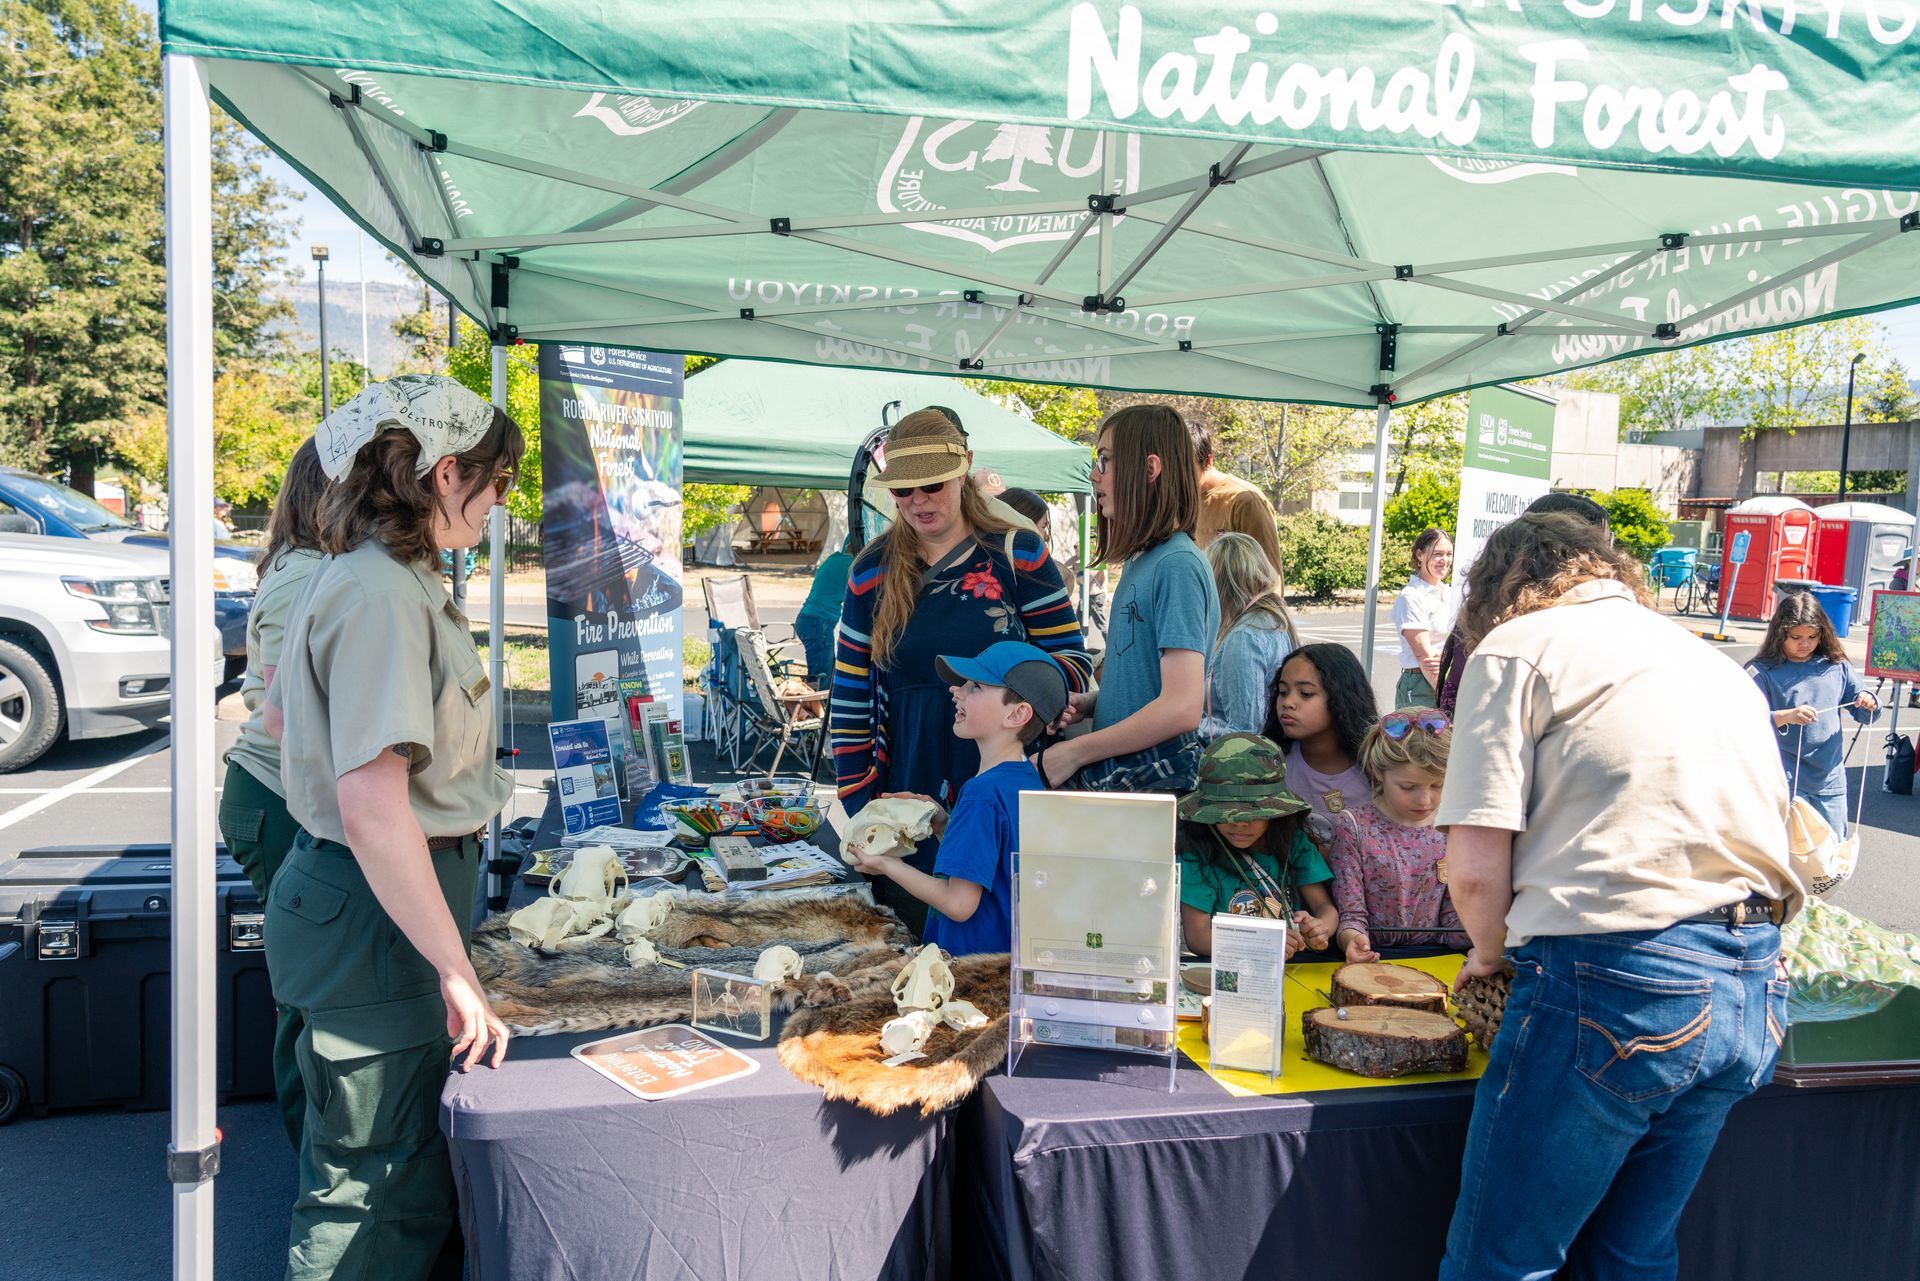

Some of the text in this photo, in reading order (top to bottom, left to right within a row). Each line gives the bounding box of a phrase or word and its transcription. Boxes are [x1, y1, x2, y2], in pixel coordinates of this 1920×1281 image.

[1066, 2, 1790, 159] National Forest
[608, 348, 647, 361] Forest Service
[563, 398, 673, 429] ROGUE RIVER-SISKIYOU
[1480, 412, 1495, 430] USDA
[590, 423, 641, 451] National
[598, 452, 636, 477] Forest
[1486, 491, 1518, 515] WELCOME
[1519, 498, 1527, 516] to
[1473, 518, 1495, 539] ROGUE
[575, 610, 674, 646] Fire Prevention
[620, 646, 674, 667] While Recreating
[620, 680, 643, 690] KNOW
[625, 1043, 694, 1079] National
[655, 1042, 707, 1066] Forest
[681, 1039, 725, 1060] LAND
